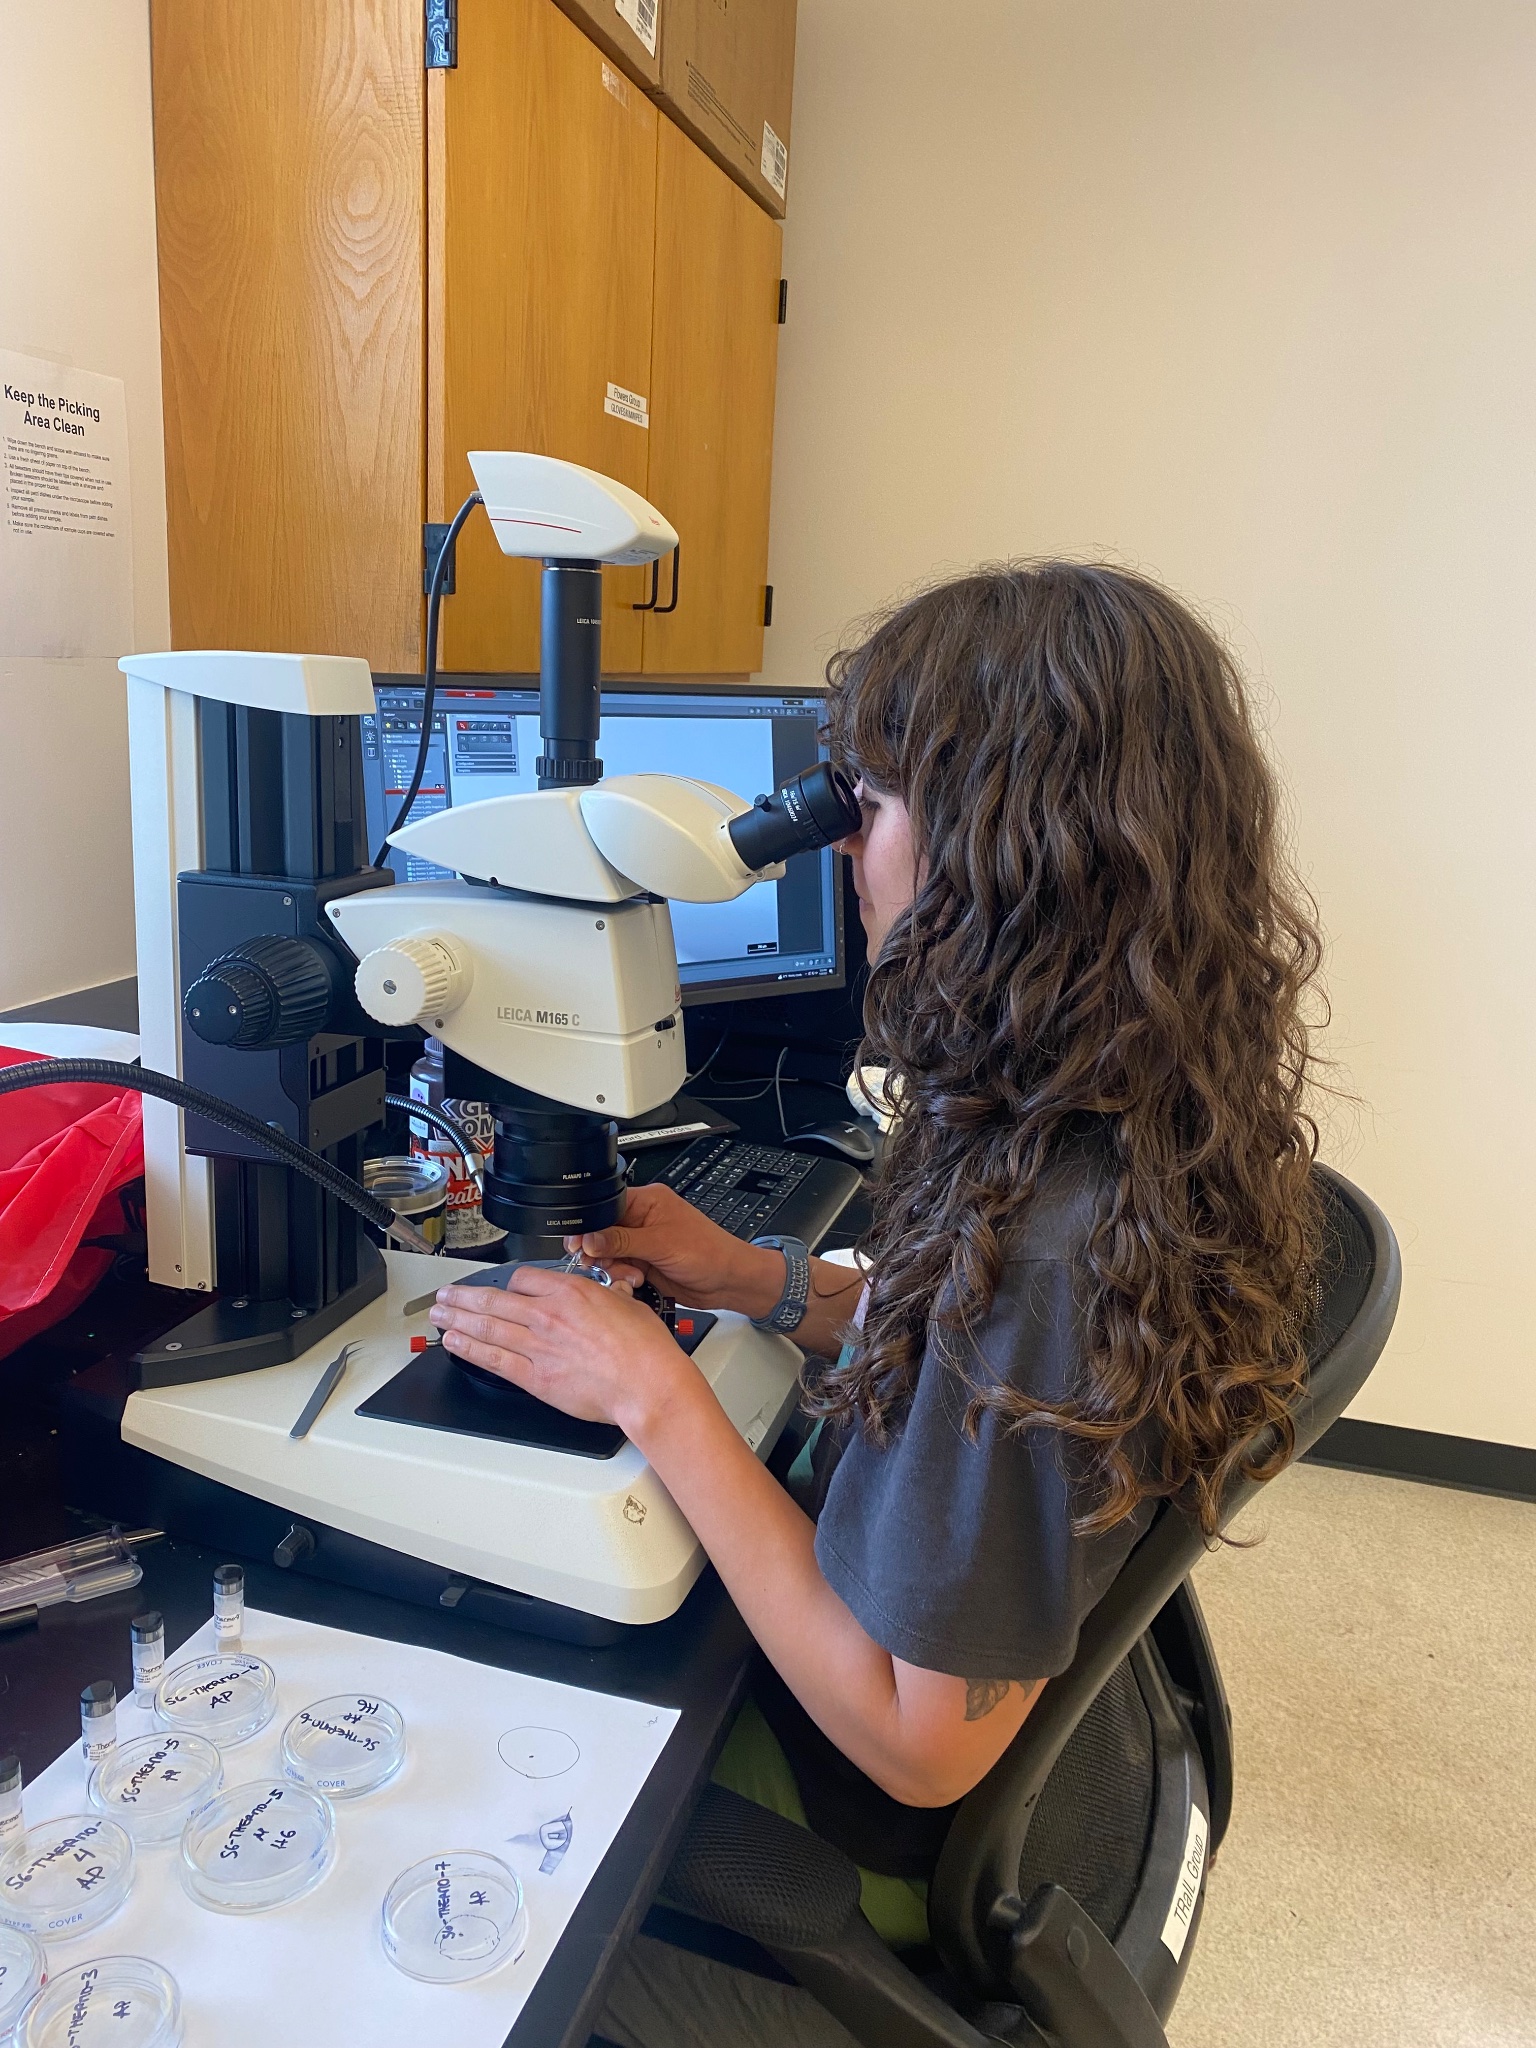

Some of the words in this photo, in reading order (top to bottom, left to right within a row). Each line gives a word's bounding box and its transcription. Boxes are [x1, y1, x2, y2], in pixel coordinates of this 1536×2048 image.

[4, 384, 34, 407] Keep
[38, 393, 55, 409] the
[58, 398, 100, 422] Picking
[24, 410, 50, 429] Area
[54, 417, 85, 436] Clean
[497, 1006, 532, 1022] LEICA
[536, 1010, 568, 1025] M165
[572, 1013, 580, 1026] C
[210, 1690, 233, 1709] AP
[1187, 1834, 1204, 1879] Group
[76, 1866, 106, 1890] AP
[48, 1913, 83, 1929] COVER
